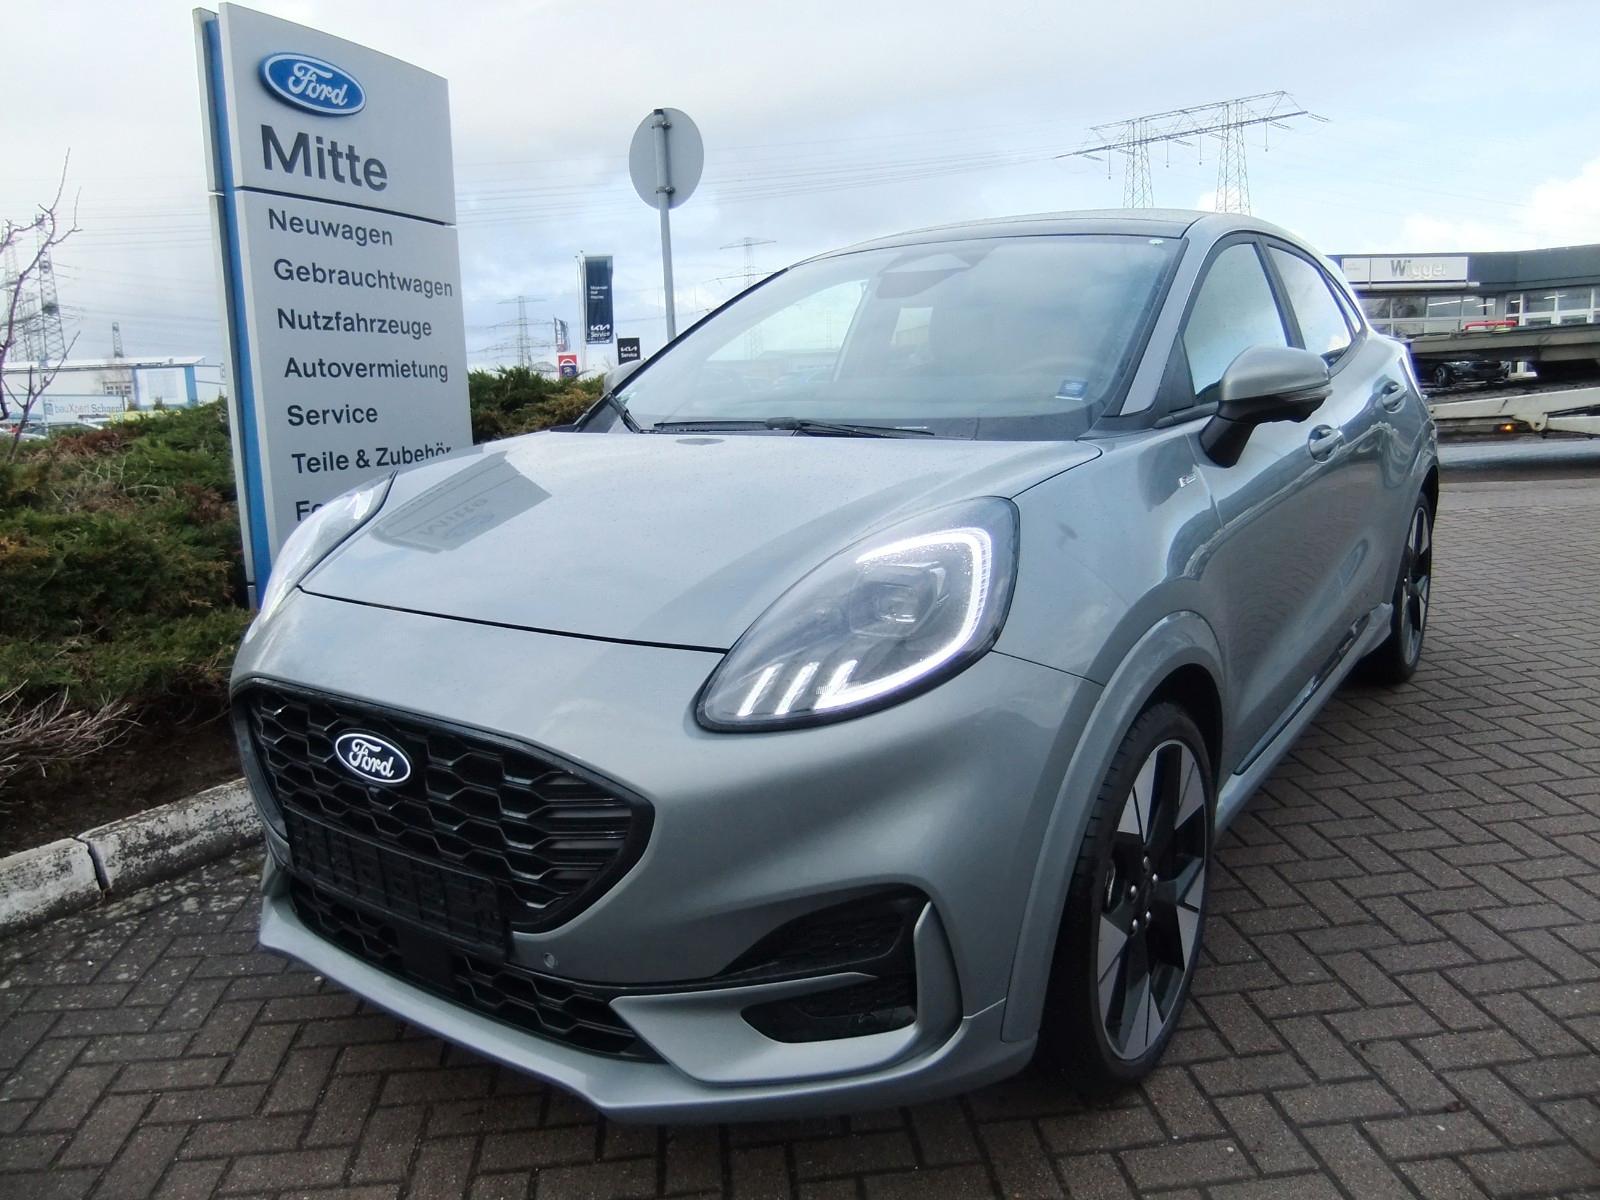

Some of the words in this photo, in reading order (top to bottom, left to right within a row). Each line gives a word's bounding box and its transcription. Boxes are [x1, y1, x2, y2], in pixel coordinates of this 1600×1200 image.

[288, 62, 348, 106] Ford
[260, 124, 388, 191] Mitte
[268, 208, 393, 246] Neuwagen
[273, 258, 453, 298] Gebrauchtwagen
[277, 308, 432, 340] Nutzfahrzeuge
[284, 357, 449, 383] Autovermietung
[287, 404, 379, 427] Service
[292, 453, 350, 474] Teile
[355, 449, 371, 469] &
[348, 738, 395, 778] Ford
